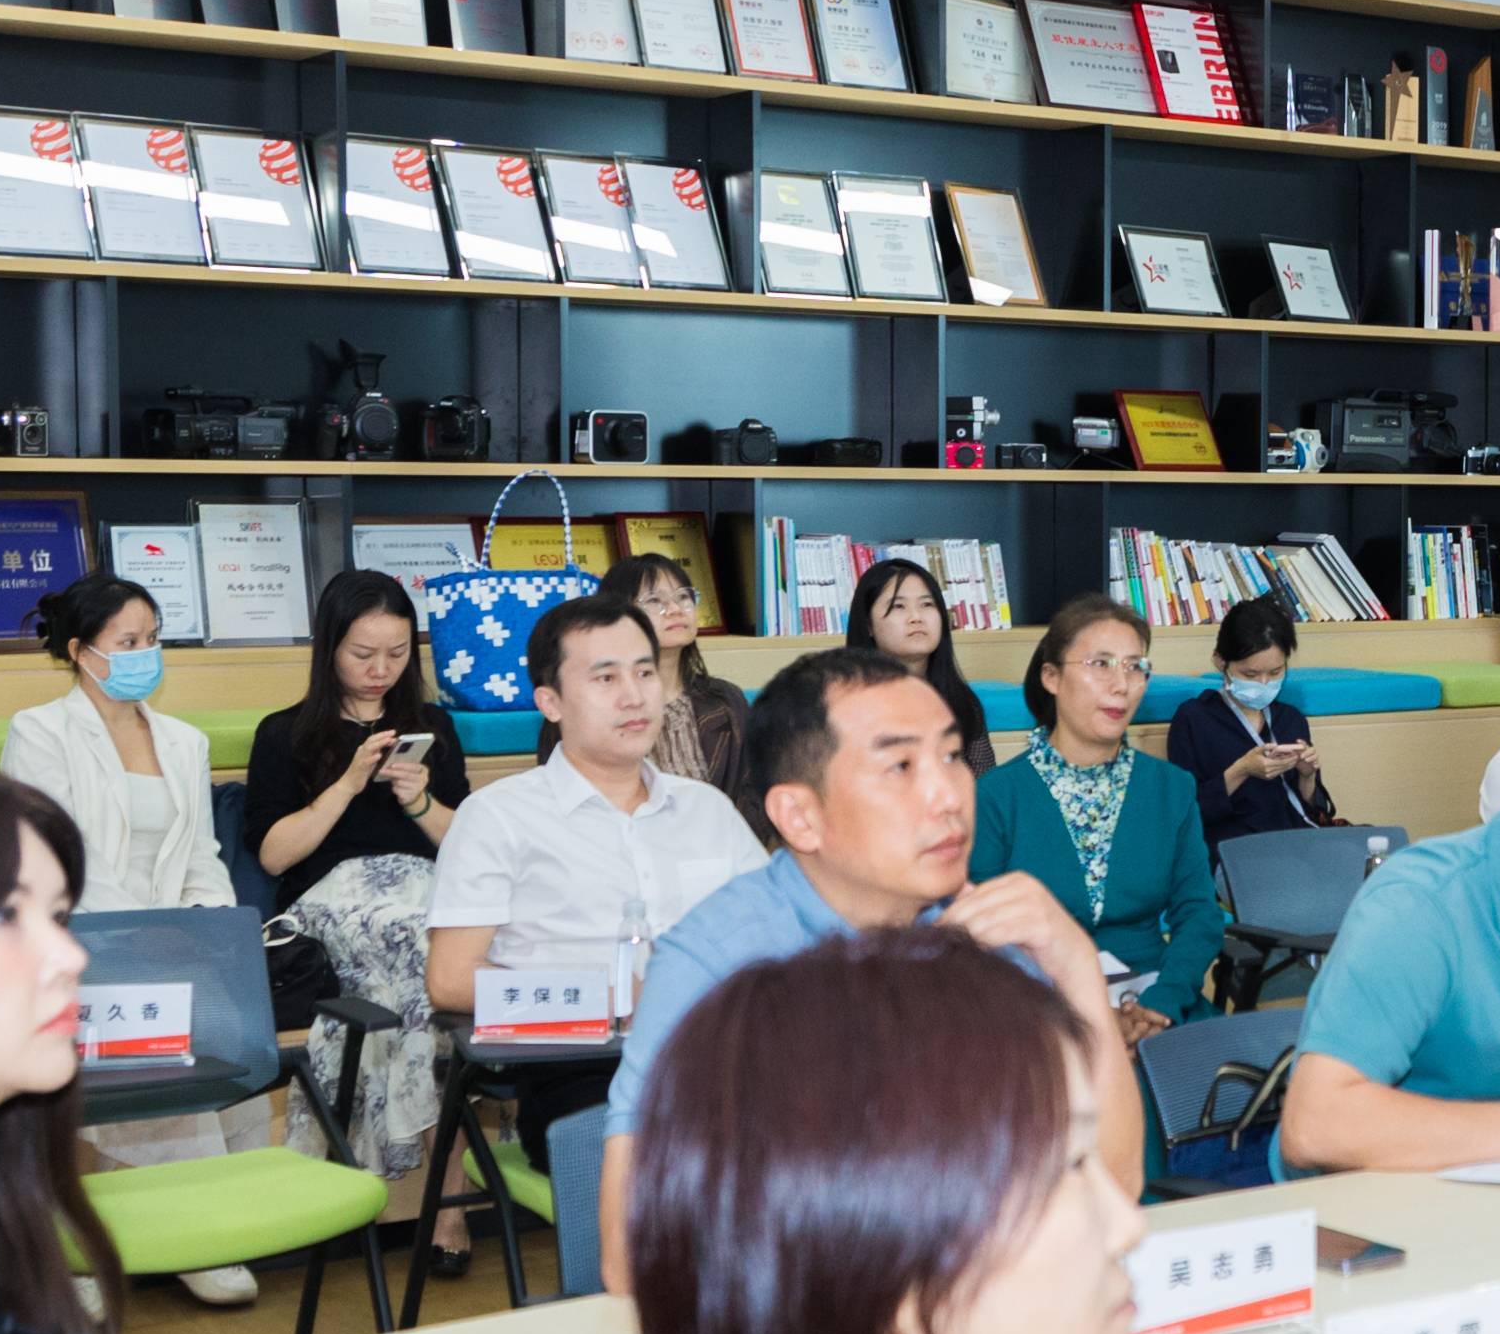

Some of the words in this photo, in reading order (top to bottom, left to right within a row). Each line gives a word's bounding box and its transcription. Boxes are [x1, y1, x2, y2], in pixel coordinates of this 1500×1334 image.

[1349, 434, 1386, 444] Panasonic
[250, 563, 291, 574] SmallRig
[502, 988, 581, 1005] 李保健
